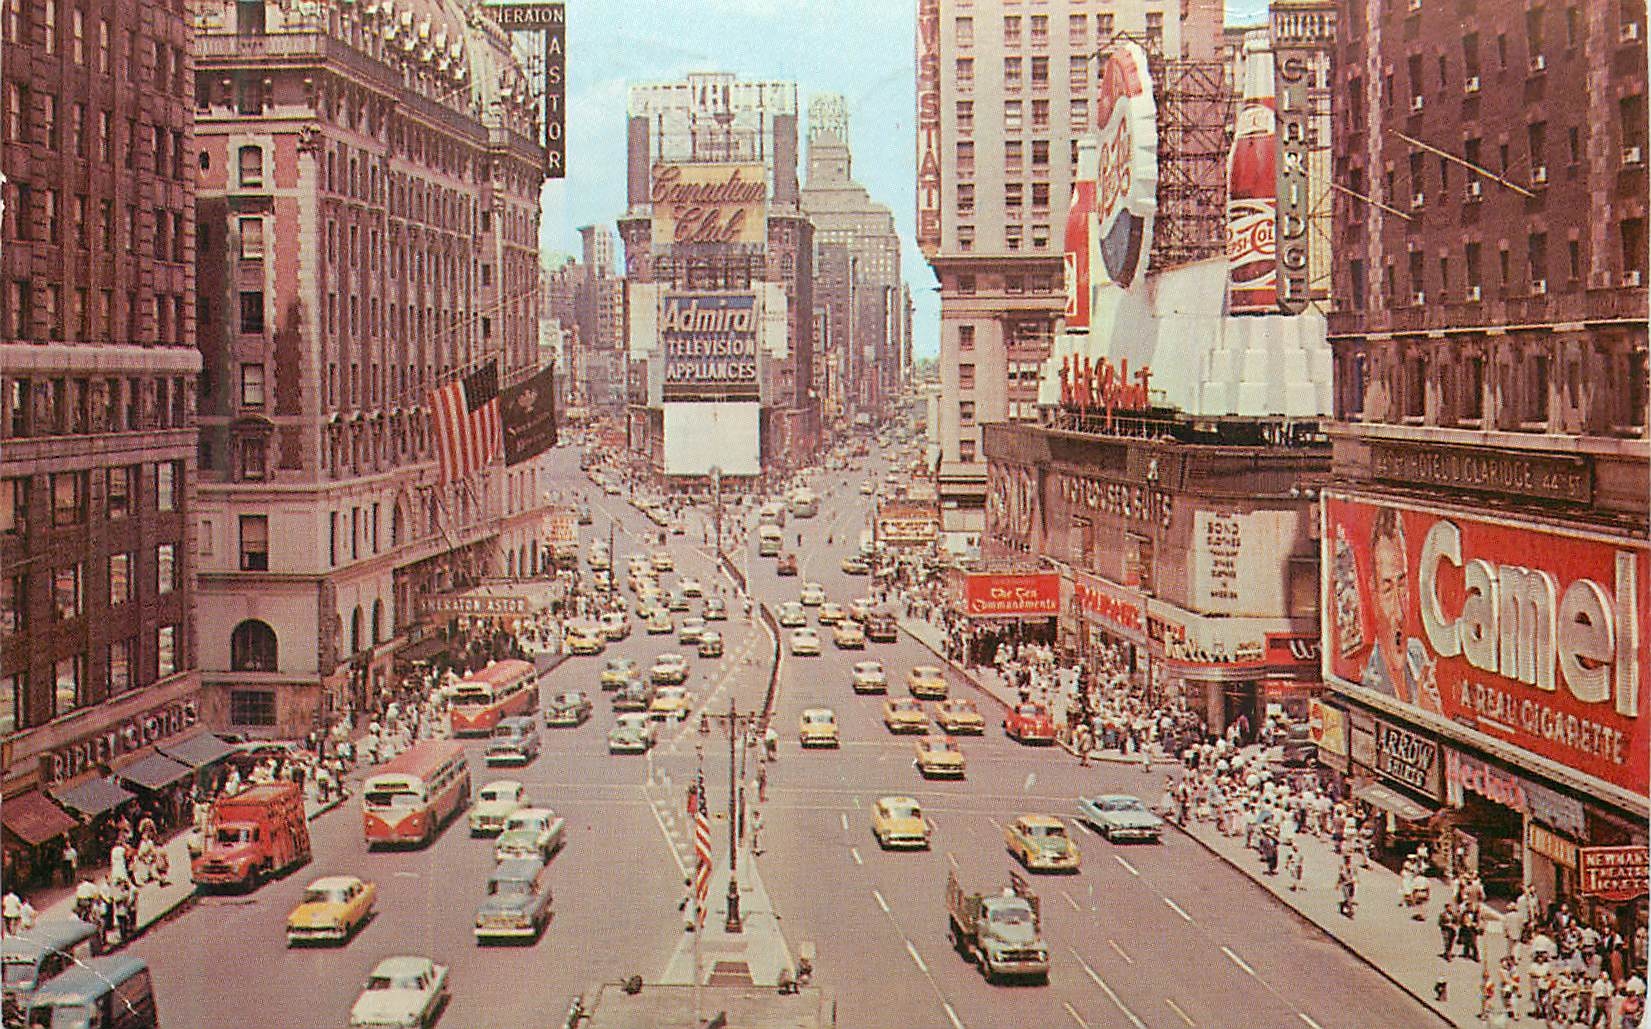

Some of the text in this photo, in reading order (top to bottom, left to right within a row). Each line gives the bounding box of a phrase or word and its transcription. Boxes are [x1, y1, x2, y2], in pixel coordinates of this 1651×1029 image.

[549, 36, 562, 169] ASTOR
[652, 164, 768, 204] Canadian
[1281, 56, 1307, 302] CLARIDGE
[673, 205, 744, 243] Club
[665, 299, 758, 332] Admiral
[668, 338, 756, 356] TELEVISION
[666, 361, 757, 380] APPLIANCES
[1463, 456, 1533, 490] CLARIDGE
[487, 597, 526, 611] ASTOR
[971, 597, 1057, 613] Commandments
[990, 587, 1038, 600] The Ten
[1419, 519, 1639, 718] Camel
[1459, 679, 1625, 764] A REAL CIGARETTE
[1376, 728, 1435, 770] ARROW
[1387, 758, 1426, 788] SHIRTS
